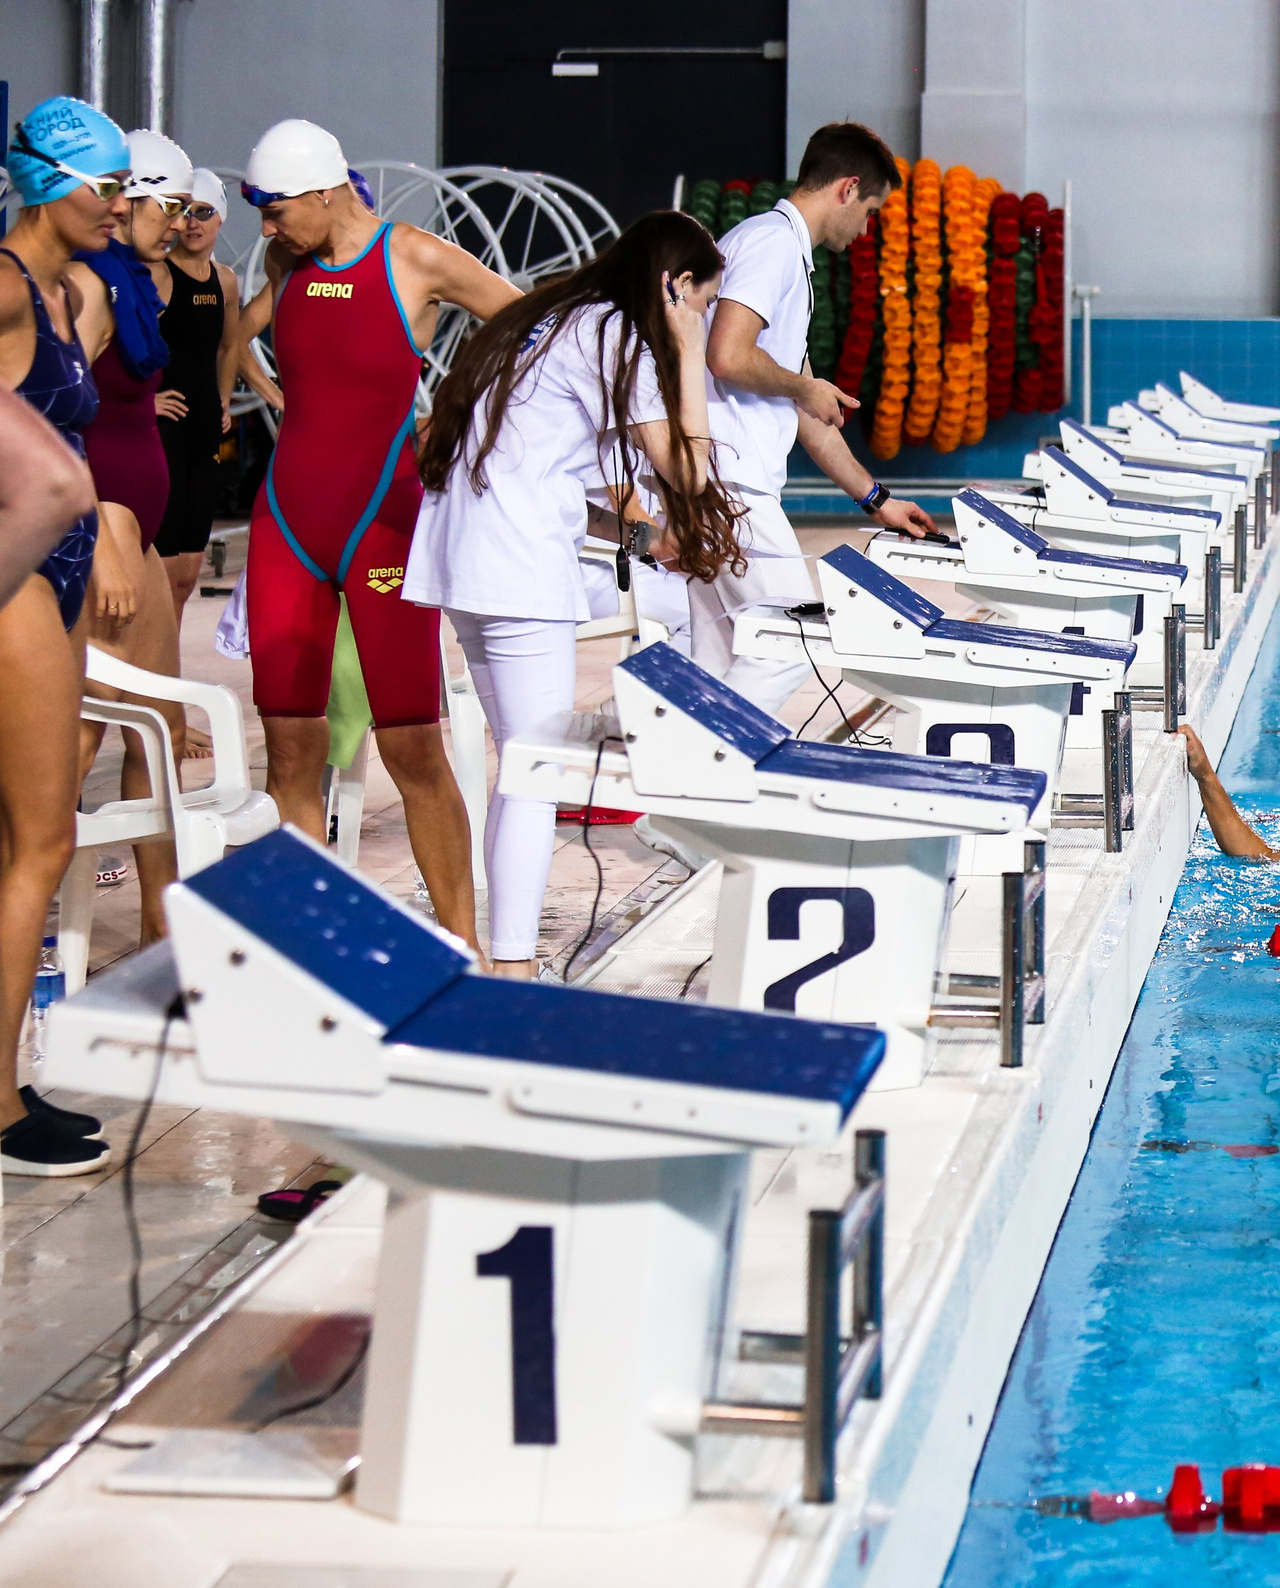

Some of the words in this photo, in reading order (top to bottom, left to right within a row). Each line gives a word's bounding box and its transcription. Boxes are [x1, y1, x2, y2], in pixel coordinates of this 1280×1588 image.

[307, 282, 354, 299] arena
[193, 294, 217, 306] arena
[368, 567, 404, 579] arena
[764, 887, 876, 1026] 2
[475, 1226, 557, 1445] 1
